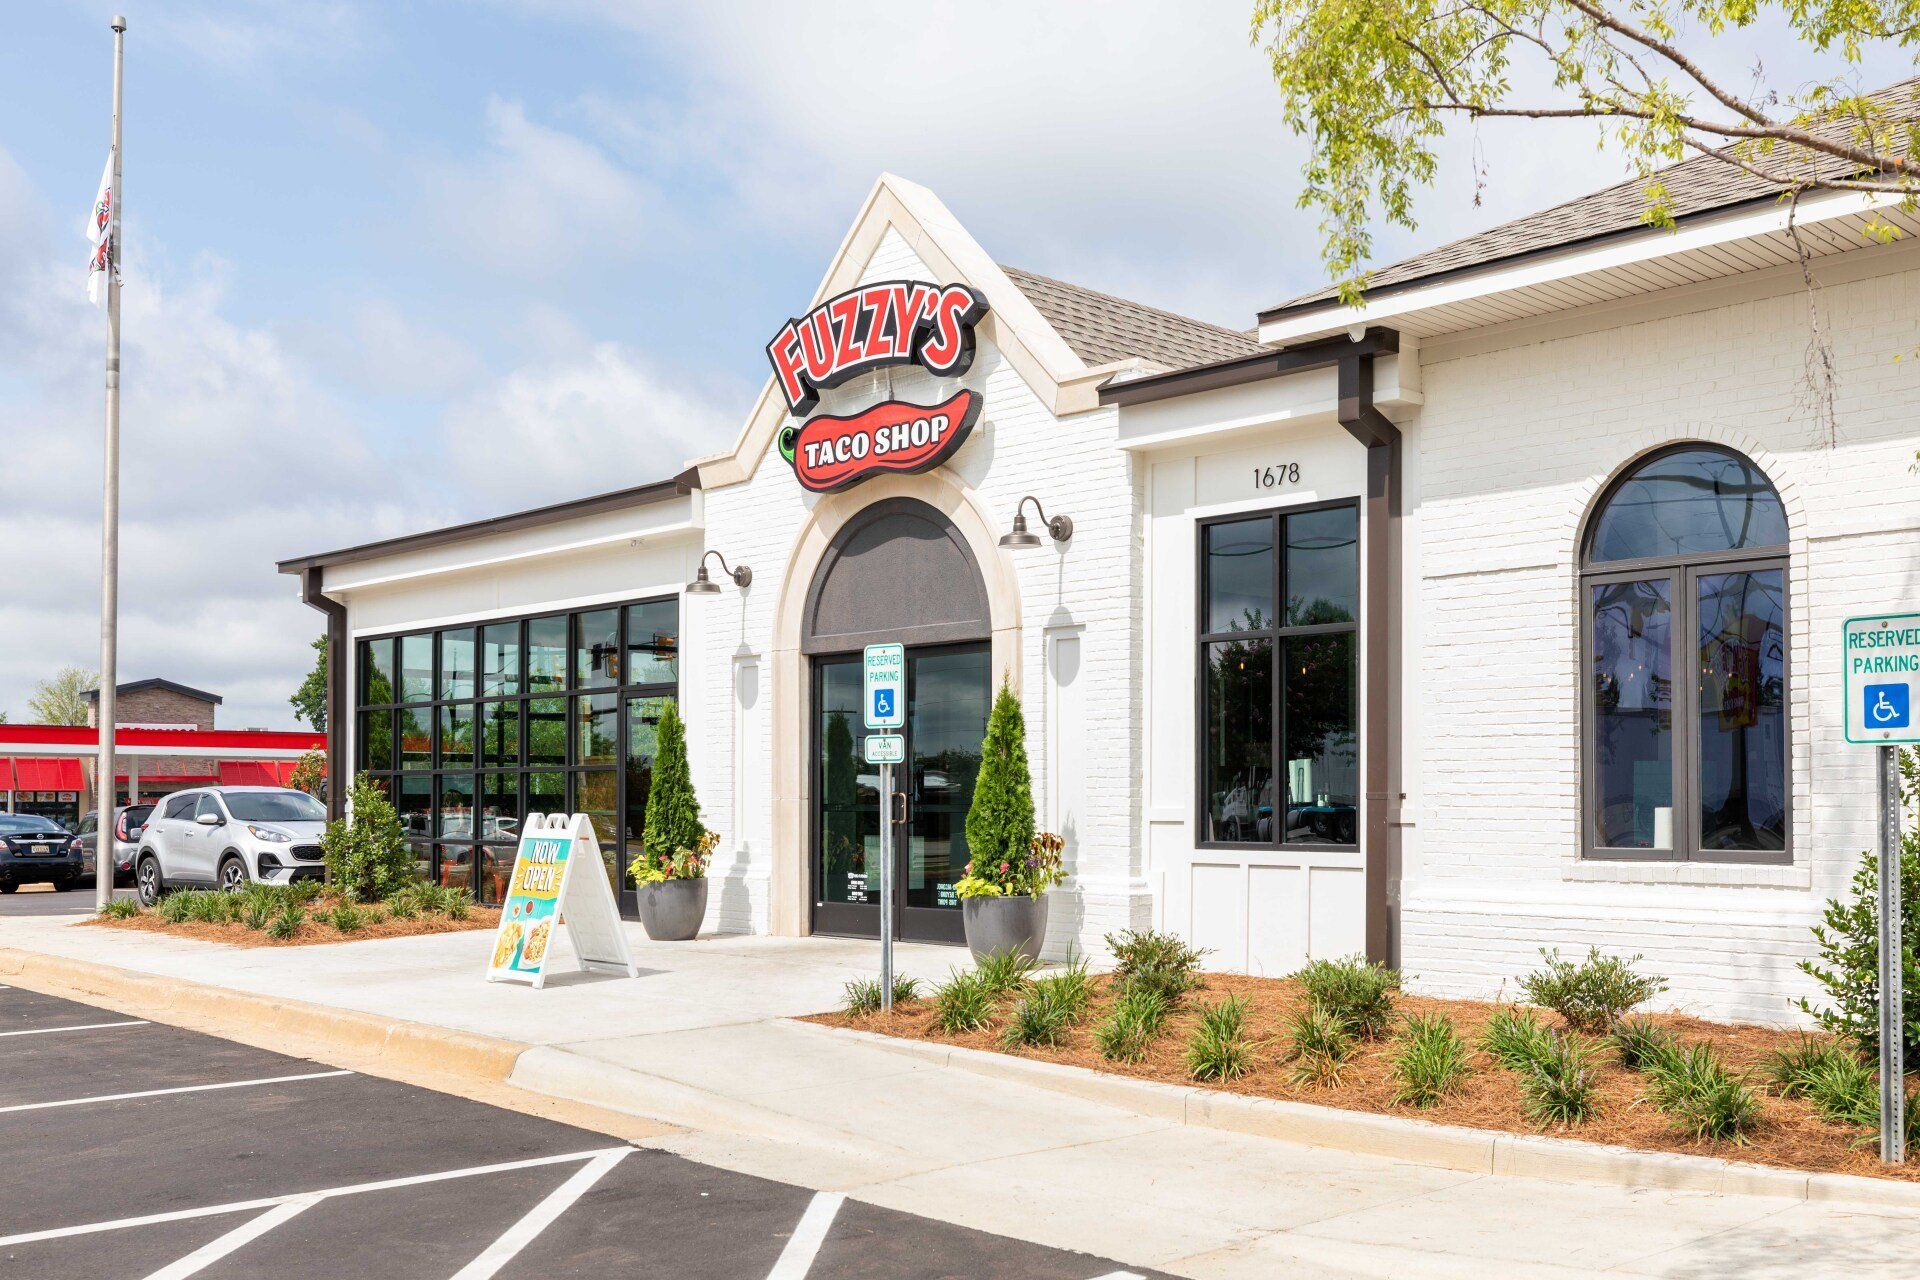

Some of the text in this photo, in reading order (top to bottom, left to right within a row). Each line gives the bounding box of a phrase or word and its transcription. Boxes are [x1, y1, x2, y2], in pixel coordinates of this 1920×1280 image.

[768, 281, 974, 409] FUZZY'S
[805, 414, 950, 468] TACO SHOP
[1254, 463, 1299, 488] 1678
[867, 654, 901, 666] RESERVED
[1853, 654, 1919, 674] PARKING
[869, 670, 898, 682] PARKING
[530, 841, 561, 864] NOW
[523, 866, 554, 892] OPEN
